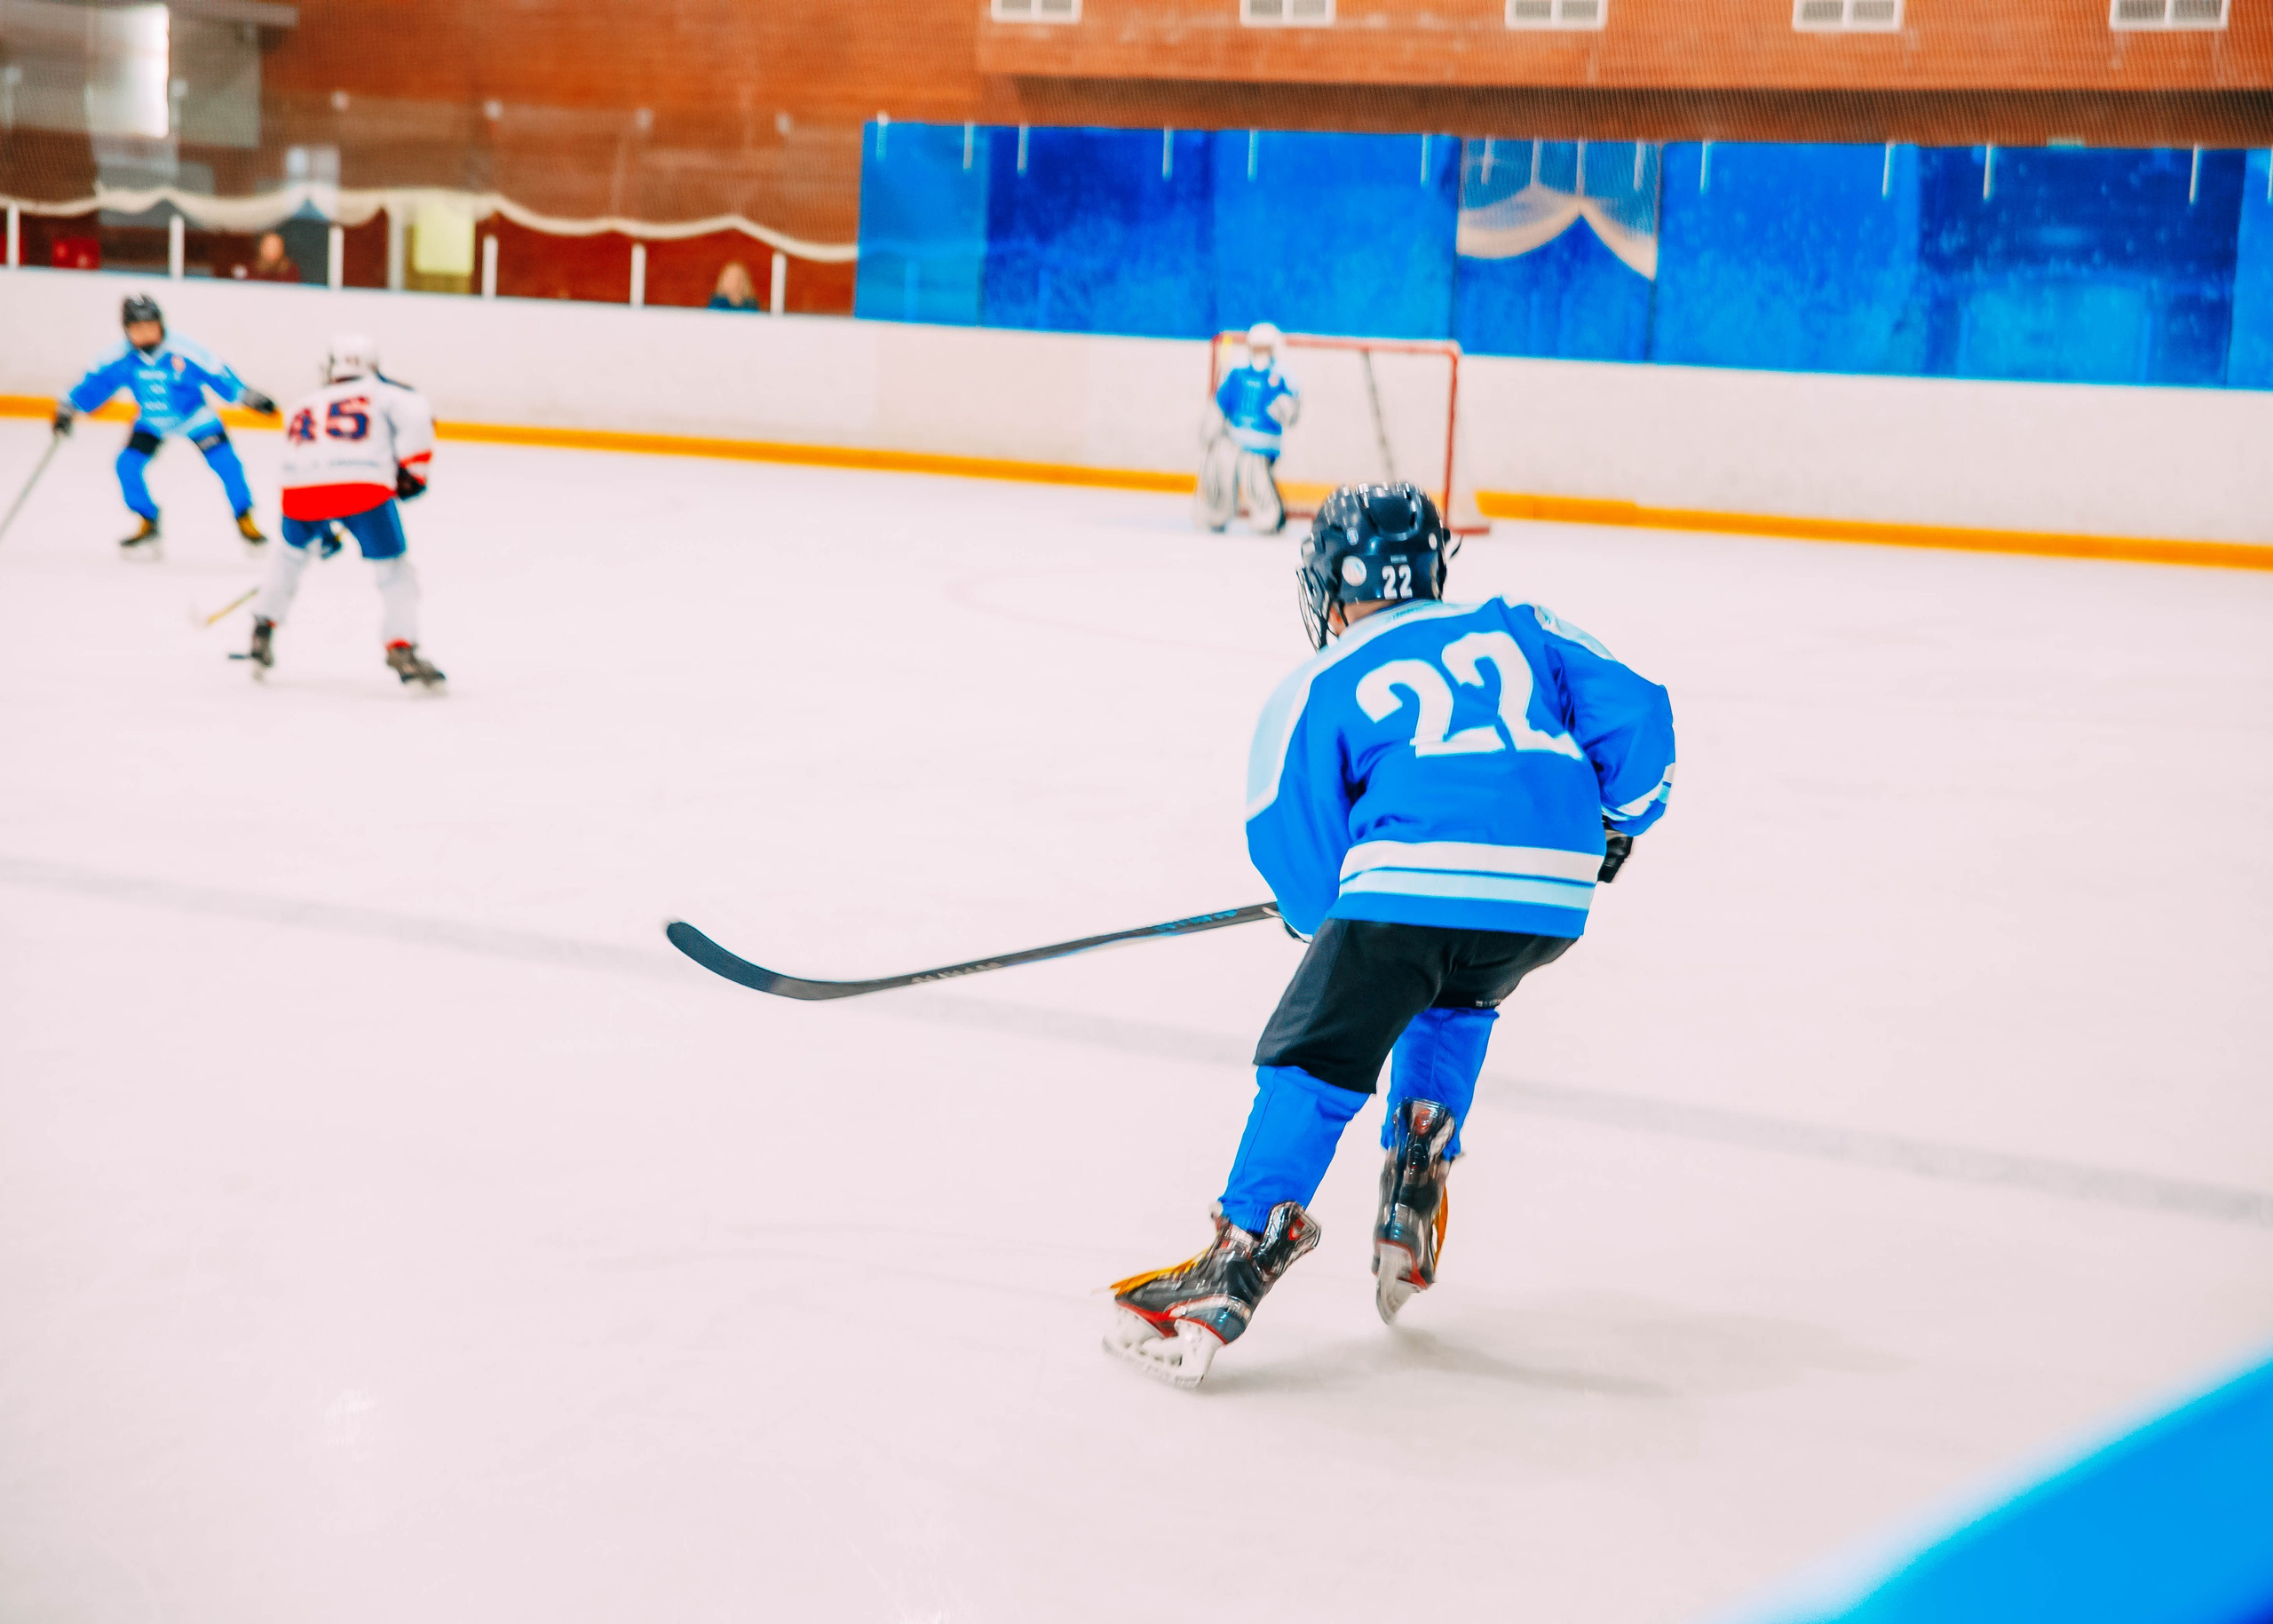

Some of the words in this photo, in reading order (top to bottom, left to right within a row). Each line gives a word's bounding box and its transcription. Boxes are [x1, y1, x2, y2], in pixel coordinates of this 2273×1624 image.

[289, 396, 369, 446] 45
[1382, 564, 1414, 599] 22
[1356, 630, 1584, 761] 22
